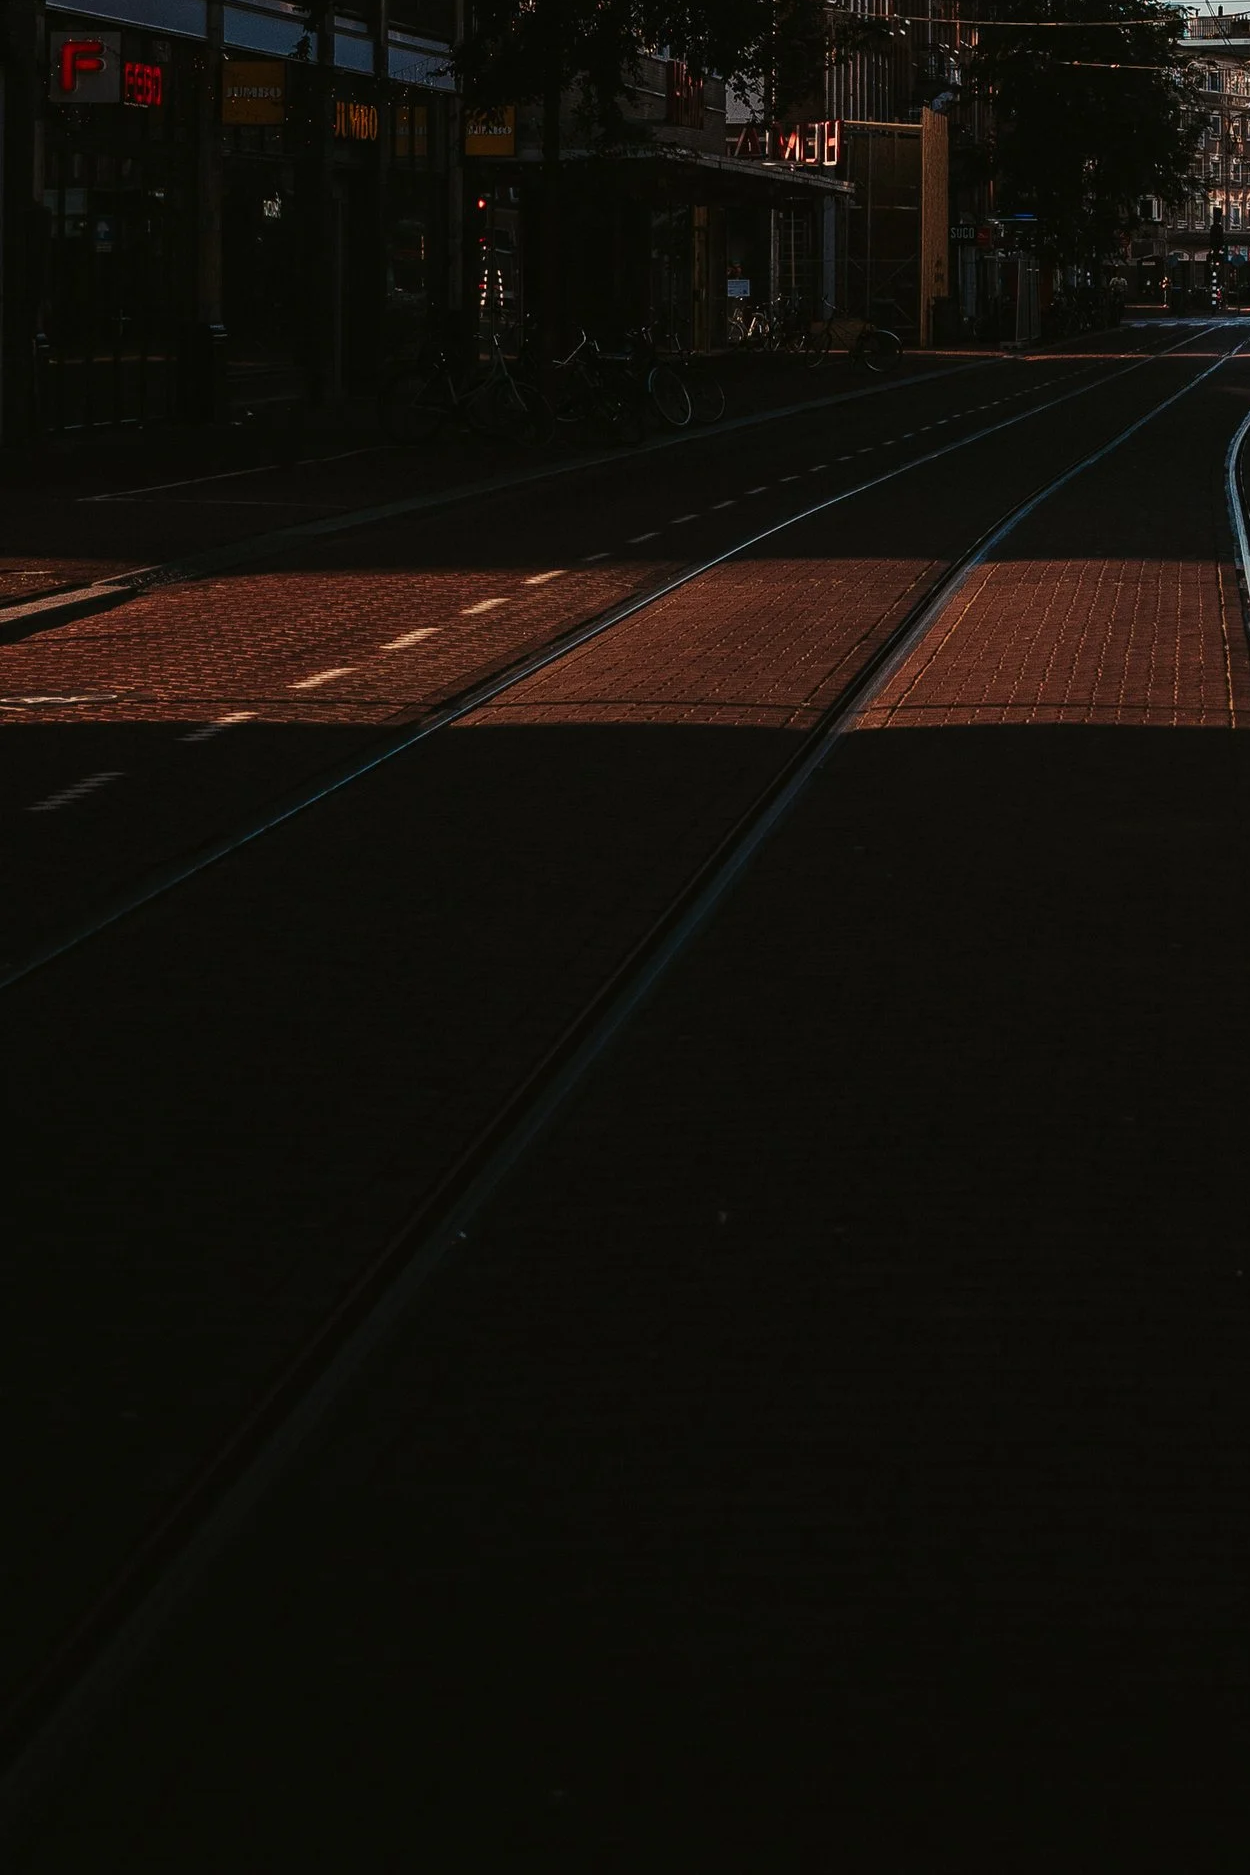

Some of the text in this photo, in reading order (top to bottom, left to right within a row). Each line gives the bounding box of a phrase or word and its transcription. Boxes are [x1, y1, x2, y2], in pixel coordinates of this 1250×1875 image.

[60, 39, 105, 92] F
[226, 85, 283, 98] JUMBO
[335, 101, 378, 141] JUMBO
